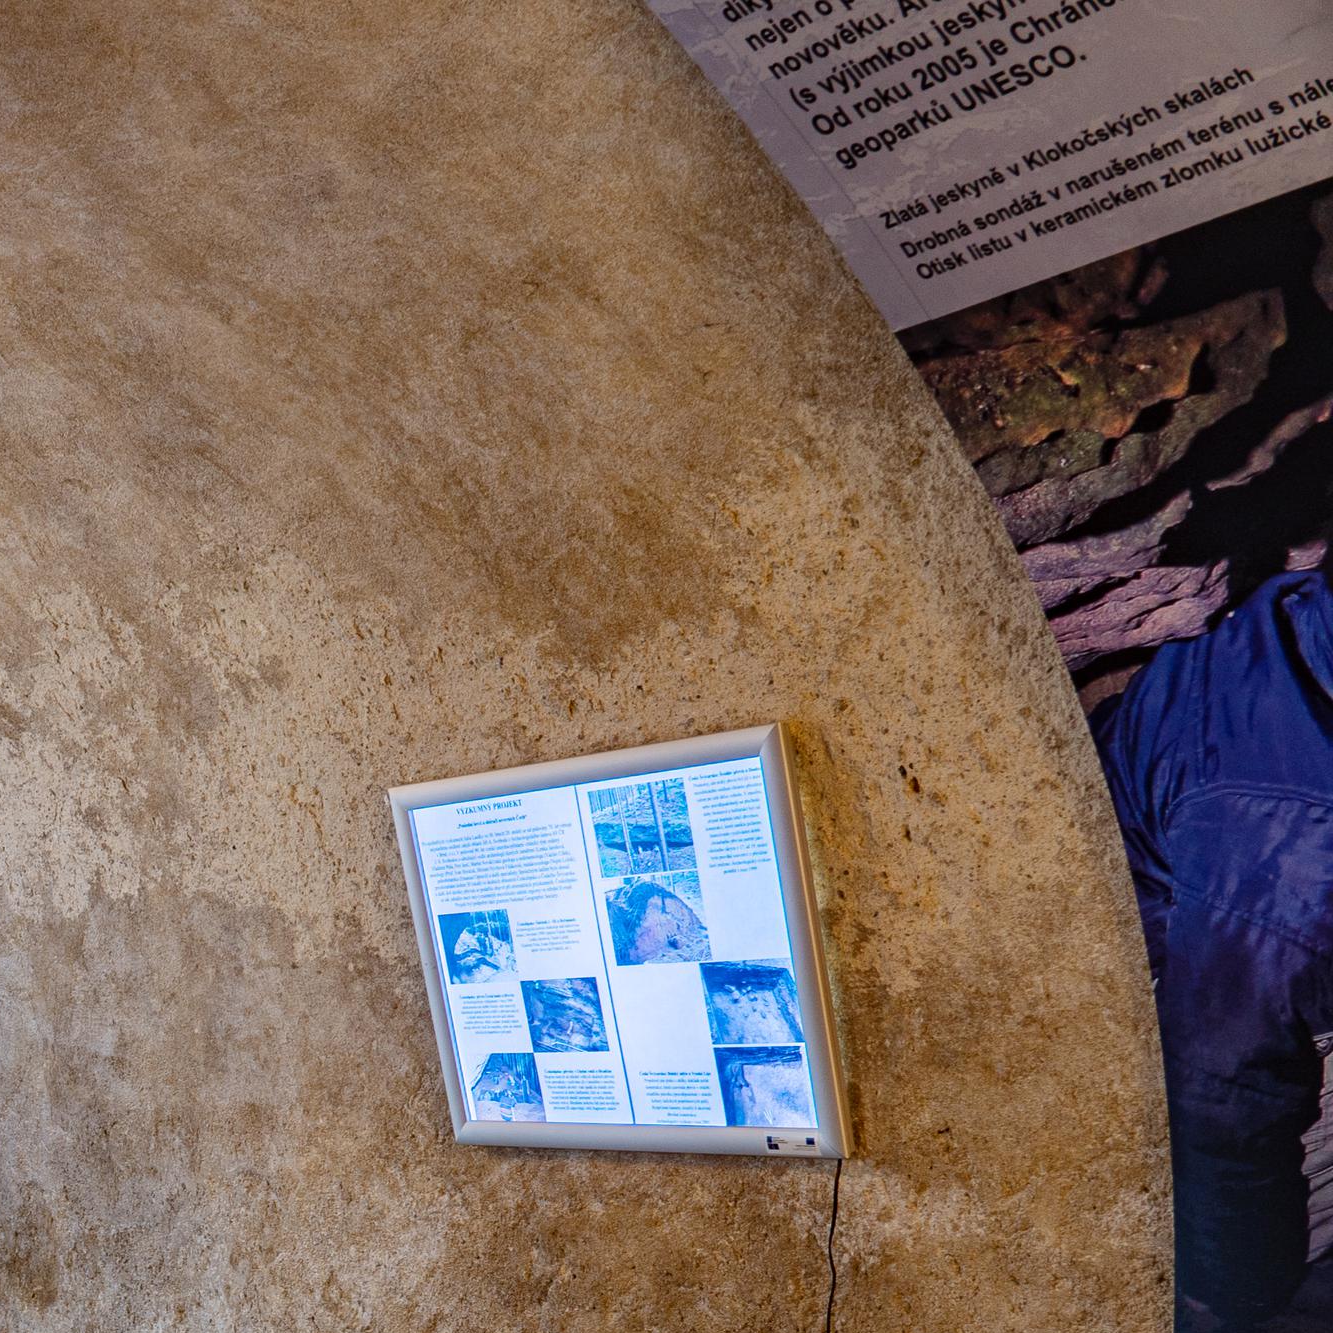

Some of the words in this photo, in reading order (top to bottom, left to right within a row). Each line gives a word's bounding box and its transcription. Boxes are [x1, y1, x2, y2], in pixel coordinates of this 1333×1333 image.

[745, 9, 813, 51] nejen
[814, 0, 833, 16] o
[768, 11, 895, 80] novověku.
[898, 0, 942, 17] Ar
[789, 86, 817, 112] (s
[817, 30, 933, 94] výjimkou
[811, 106, 853, 136] Od
[854, 82, 913, 120] roku
[912, 47, 978, 91] 2005
[977, 37, 1009, 66] je
[835, 100, 953, 170] geoparků
[950, 45, 1087, 111] UNESCO.
[879, 200, 929, 230] Zlatá
[927, 168, 1005, 214] jeskyně
[1007, 163, 1021, 177] v
[1022, 106, 1161, 171] Klokočských
[1164, 68, 1255, 114] skalách
[900, 220, 973, 258] Drobná
[973, 190, 1048, 231] sondáž
[1047, 187, 1061, 201] v
[1065, 137, 1186, 195] narušeném
[1187, 107, 1265, 146] terénu
[1268, 101, 1285, 115] s
[916, 250, 968, 280] Otisk
[967, 235, 1013, 261] listu
[1014, 229, 1028, 242] v
[1029, 179, 1158, 237] keramickém
[1160, 147, 1244, 188] zlomku
[1244, 110, 1332, 156] lužické
